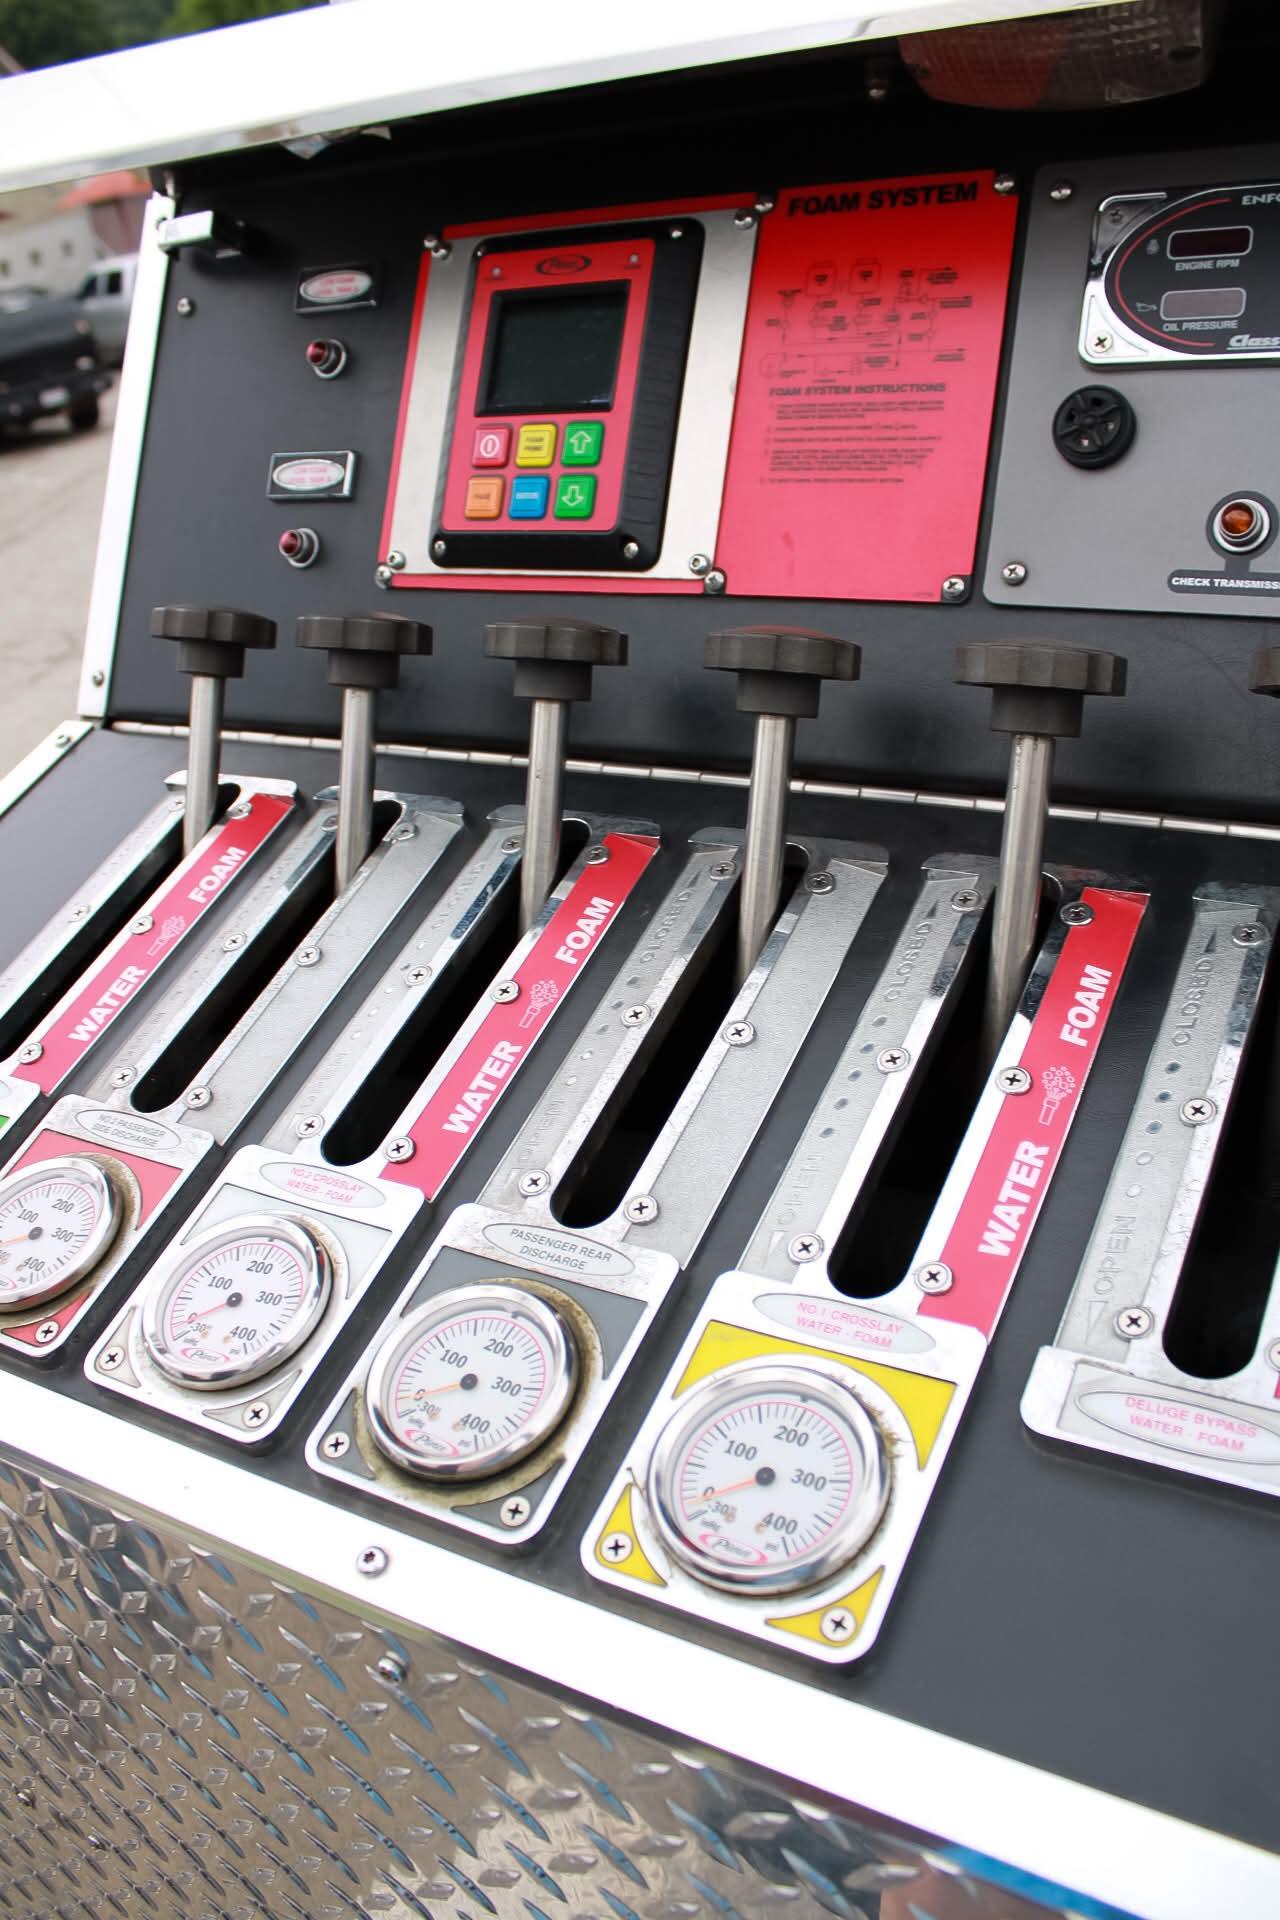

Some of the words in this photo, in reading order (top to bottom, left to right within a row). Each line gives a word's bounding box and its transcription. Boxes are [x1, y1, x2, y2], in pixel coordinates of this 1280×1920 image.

[788, 186, 860, 217] FOAM
[868, 180, 978, 211] SYSTEM
[1175, 260, 1214, 271] ENGINE
[1216, 258, 1240, 269] RPM
[1162, 323, 1180, 332] OIL
[1182, 319, 1238, 331] PRESSURE
[768, 386, 802, 397] FOAM
[804, 384, 851, 396] SYSTEM
[854, 382, 946, 395] INSTRUCTIONS
[1171, 577, 1210, 586] CHECK
[188, 847, 246, 903] FOAM
[555, 896, 615, 965] FOAM
[67, 965, 147, 1042] WATER
[1060, 964, 1113, 1046] FOAM
[1170, 956, 1215, 1048] CLOSED
[442, 1039, 524, 1136] WATER
[287, 1180, 320, 1193] WATER
[326, 1189, 353, 1202] FOAM
[313, 1173, 365, 1193] CROSSLAY
[51, 1198, 75, 1214] 200
[978, 1140, 1050, 1256] WATER
[17, 1208, 40, 1224] 100
[51, 1226, 75, 1243] 300
[510, 1227, 578, 1254] PASSENGER
[579, 1246, 613, 1263] REAR
[23, 1256, 46, 1272] 400
[519, 1244, 588, 1271] DISCHARGE
[1094, 1214, 1138, 1297] OPEN
[246, 1260, 273, 1275] 200
[207, 1275, 233, 1291] 100
[255, 1290, 283, 1306] 300
[230, 1325, 257, 1341] 400
[796, 1316, 843, 1337] WATER
[855, 1330, 893, 1349] FOAM
[831, 1309, 904, 1336] CROSSLAY
[438, 1348, 468, 1369] 100
[483, 1338, 514, 1358] 200
[491, 1375, 522, 1397] 300
[460, 1412, 491, 1434] 400
[1125, 1395, 1190, 1423] DELUGE
[1193, 1411, 1258, 1440] BYPASS
[773, 1425, 809, 1447] 200
[1129, 1415, 1185, 1437] WATER
[1196, 1430, 1246, 1454] FOAM
[724, 1438, 758, 1461] 100
[791, 1467, 827, 1491] 300
[761, 1511, 799, 1535] 400
